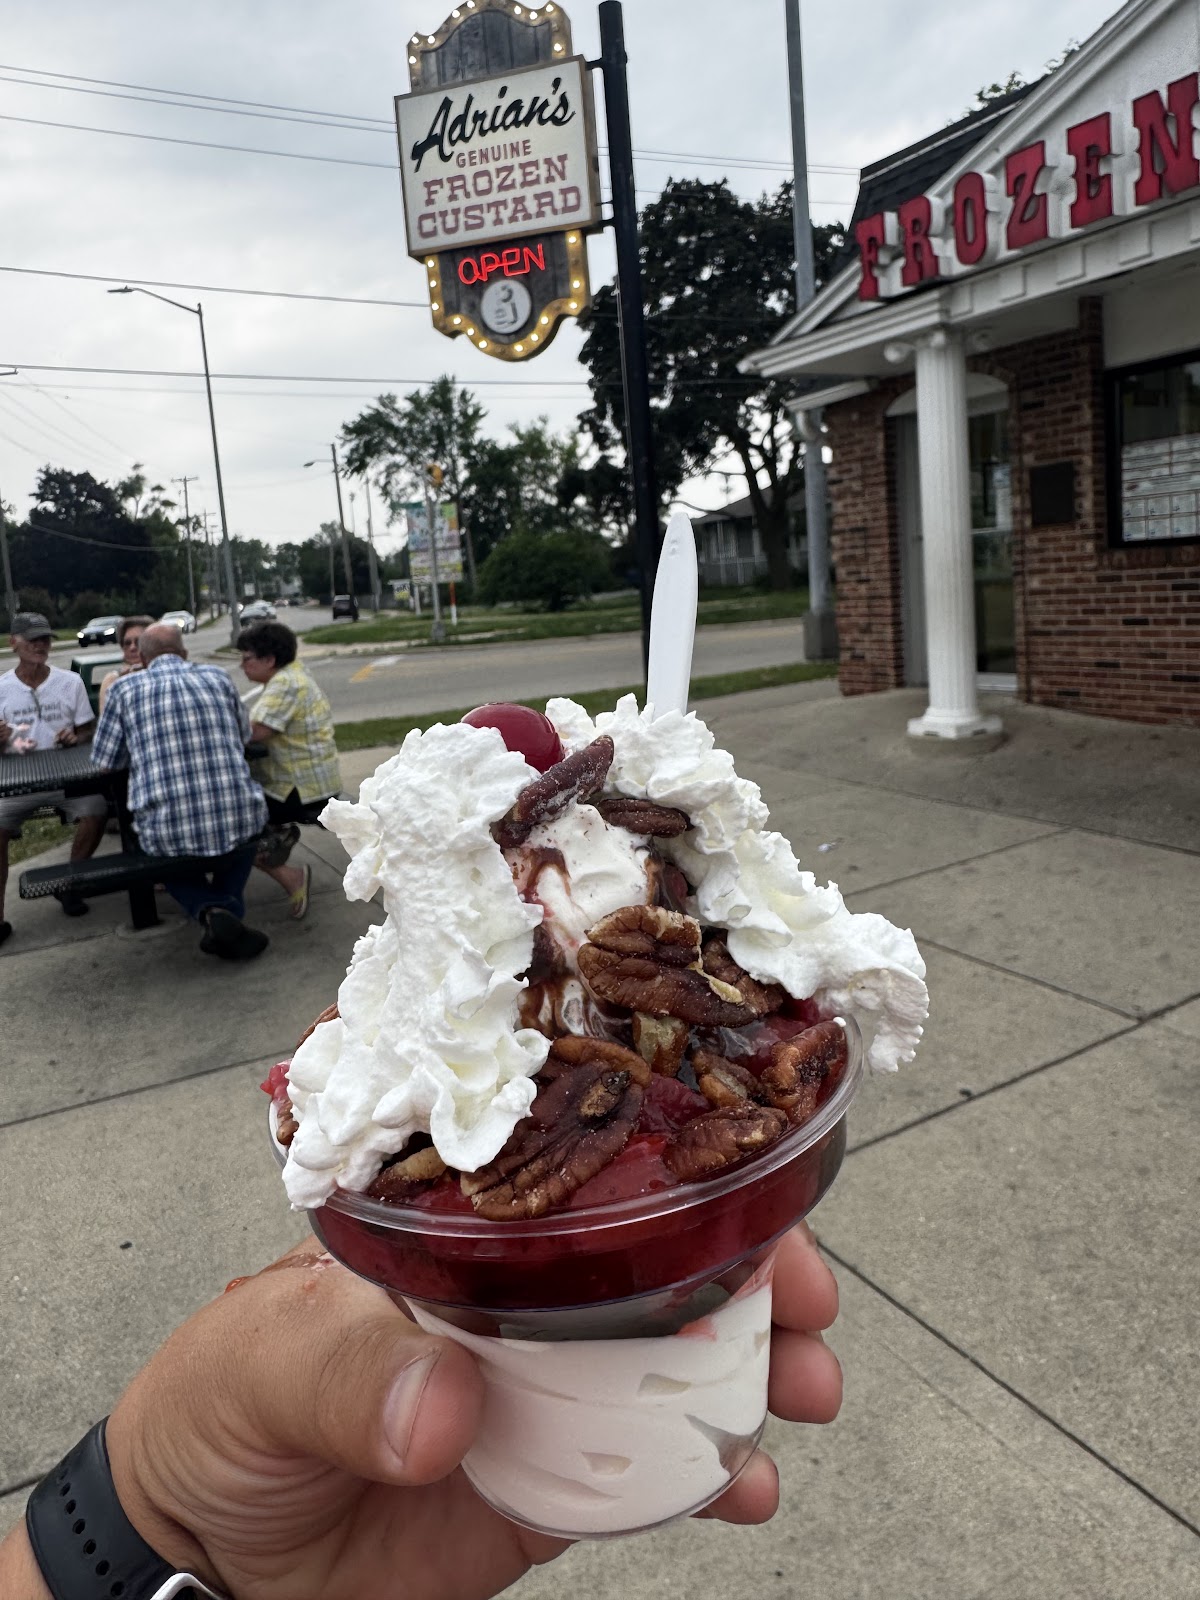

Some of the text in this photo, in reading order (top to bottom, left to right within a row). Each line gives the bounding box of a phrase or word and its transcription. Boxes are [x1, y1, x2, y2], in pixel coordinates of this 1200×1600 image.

[411, 77, 576, 172] Adrian's
[422, 153, 569, 207] FROZEN
[455, 139, 532, 169] GENUINE
[417, 185, 582, 239] CUSTARD
[855, 71, 1200, 302] FROZEN
[457, 243, 546, 285] OPEN
